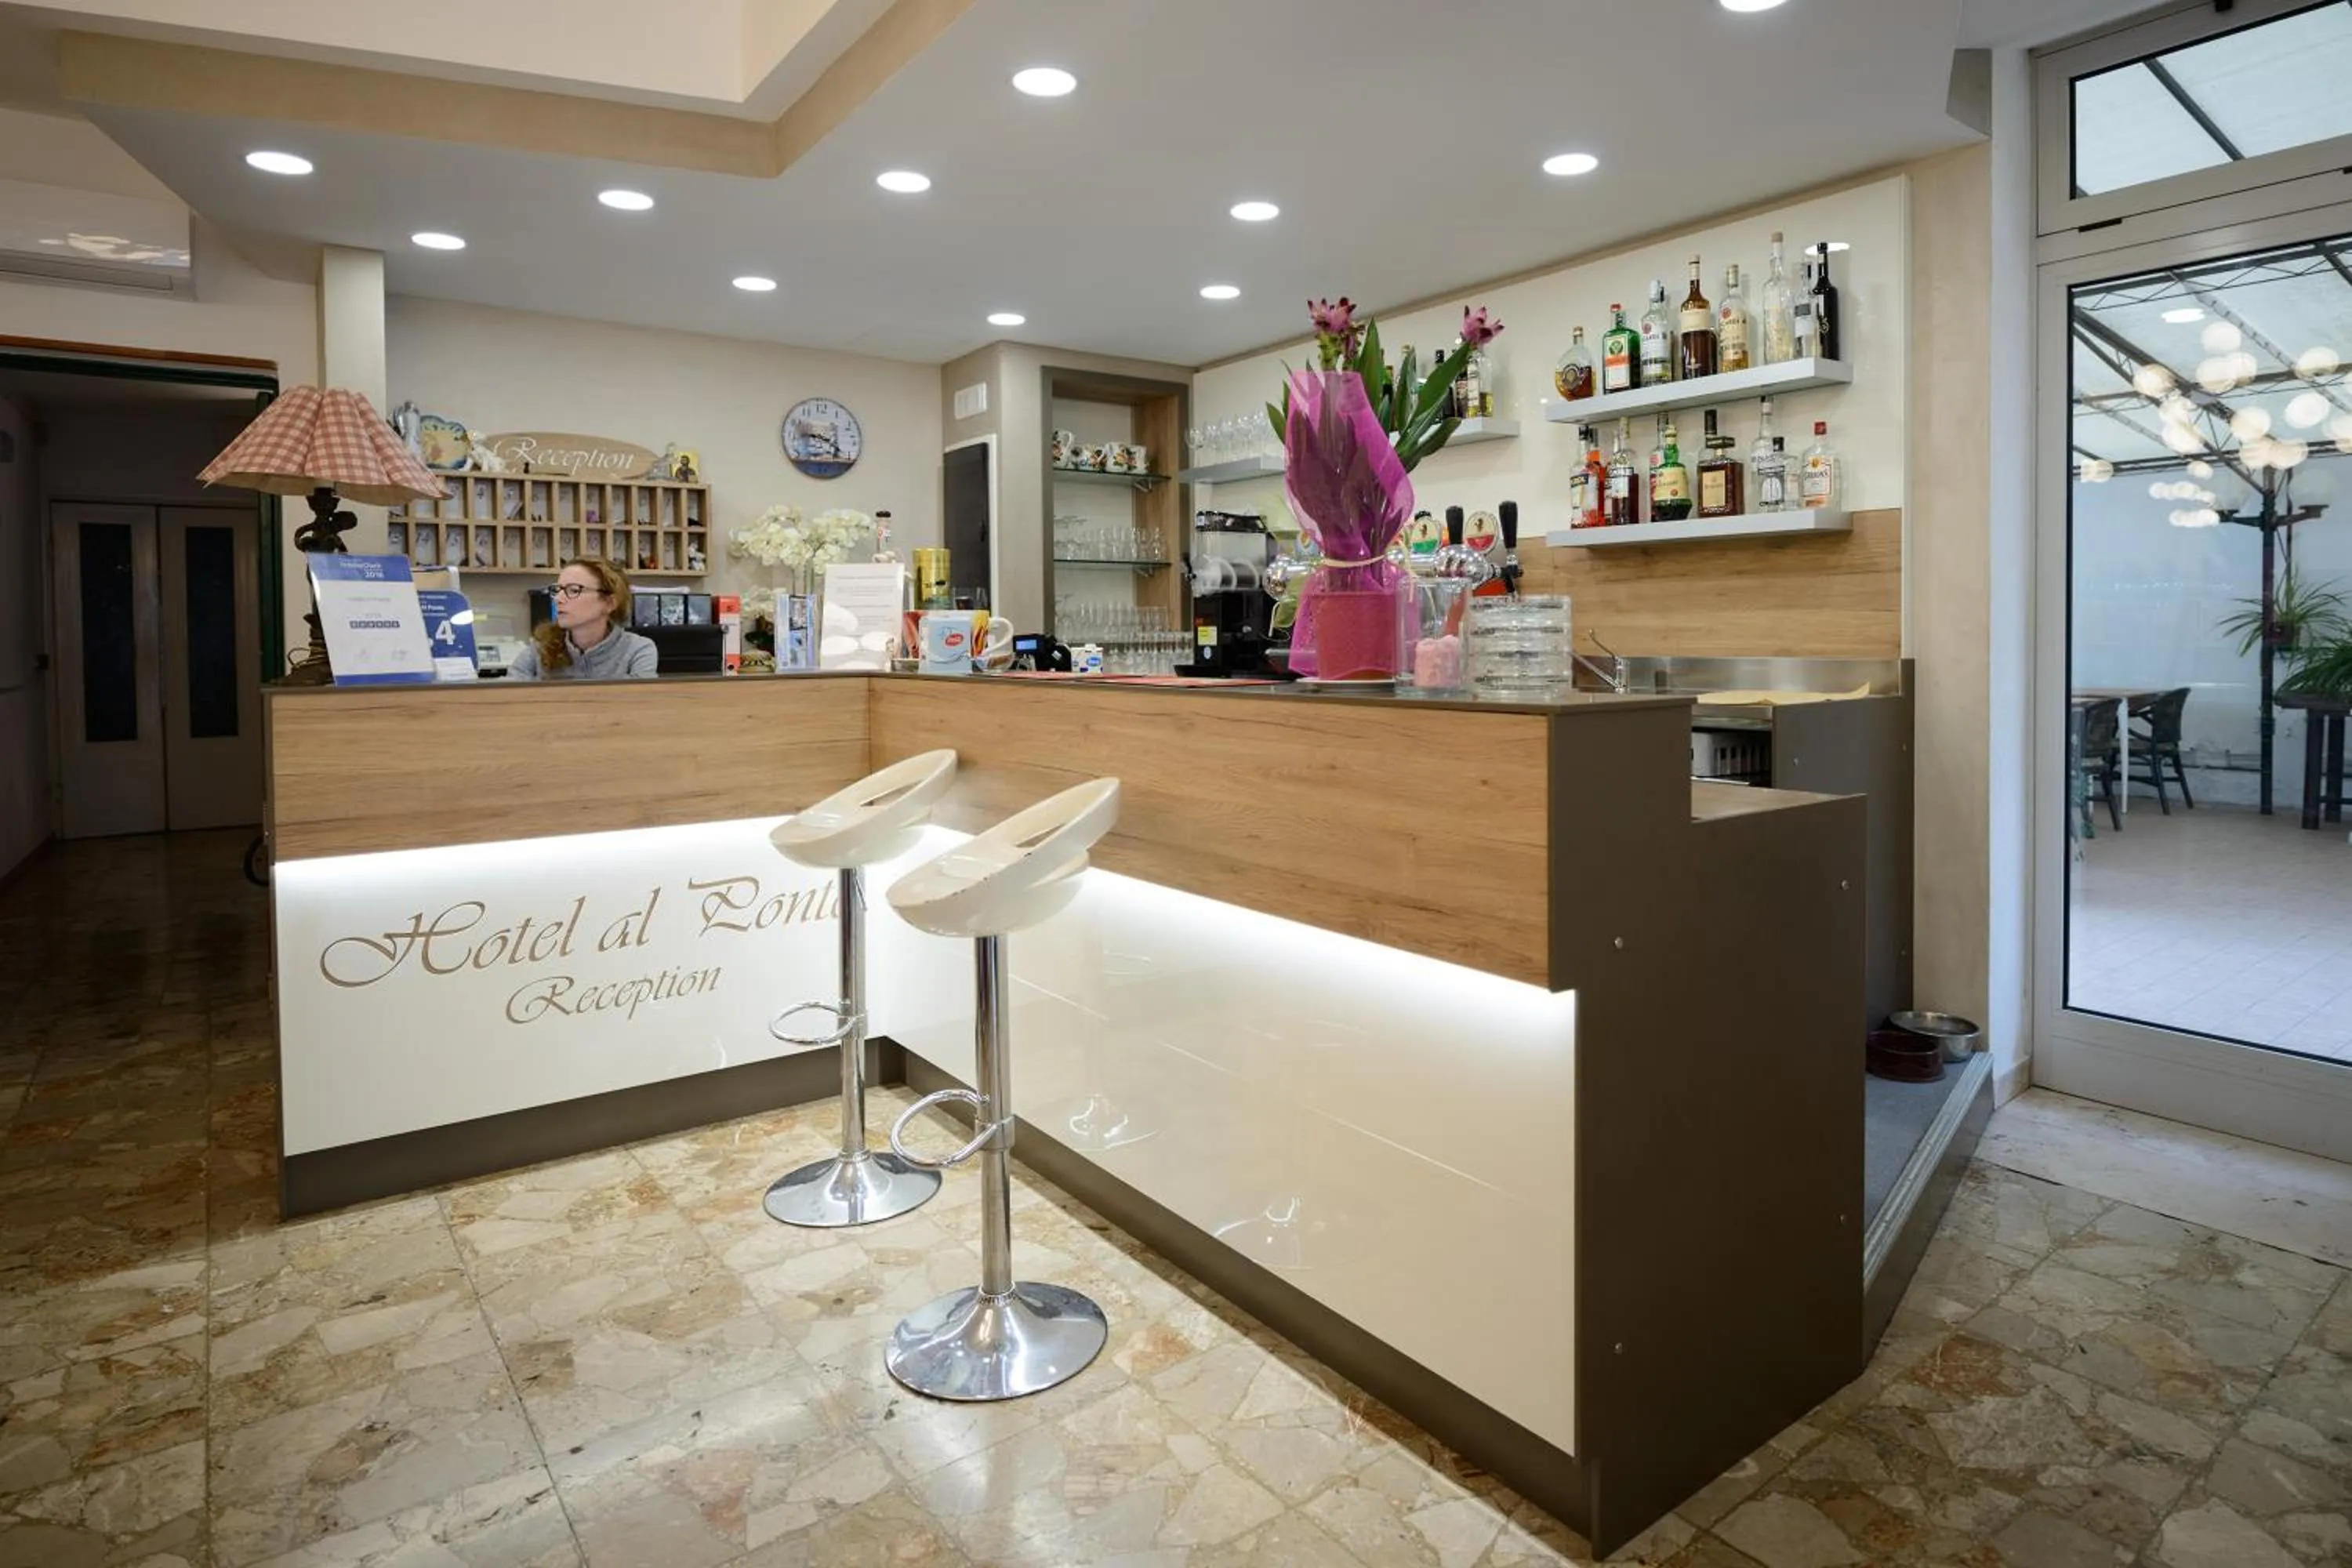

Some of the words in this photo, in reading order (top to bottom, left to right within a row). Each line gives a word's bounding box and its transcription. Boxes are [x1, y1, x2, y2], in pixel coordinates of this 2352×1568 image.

[492, 436, 634, 477] Reception
[320, 895, 586, 988] Hotel
[597, 886, 662, 954] al
[504, 962, 722, 1025] Reception
